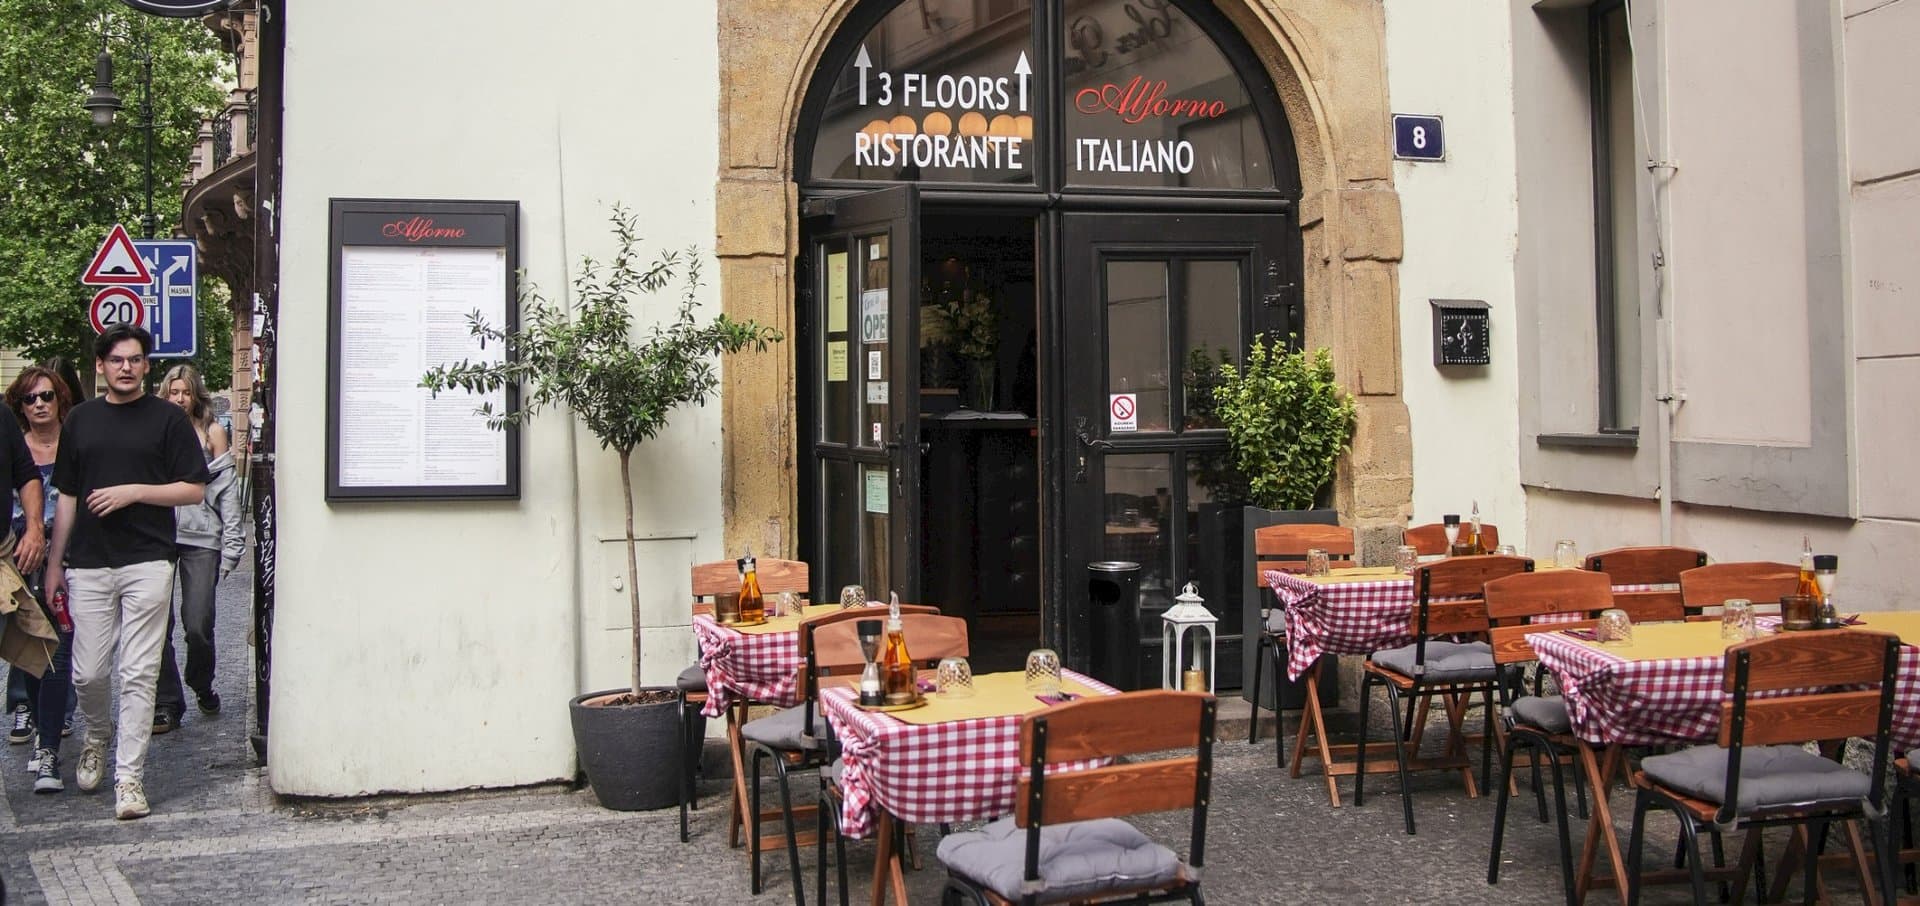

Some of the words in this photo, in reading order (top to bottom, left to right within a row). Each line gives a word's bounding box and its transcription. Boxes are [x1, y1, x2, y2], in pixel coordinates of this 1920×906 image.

[878, 72, 893, 106] 3
[904, 73, 1010, 111] FLOORS
[1075, 76, 1226, 123] Alforno
[1413, 125, 1426, 149] 8
[855, 131, 1023, 170] RISTORANTE
[1076, 138, 1194, 174] ITALIANO
[382, 216, 466, 241] Alforno
[102, 301, 133, 326] 20
[864, 314, 888, 339] OPE
